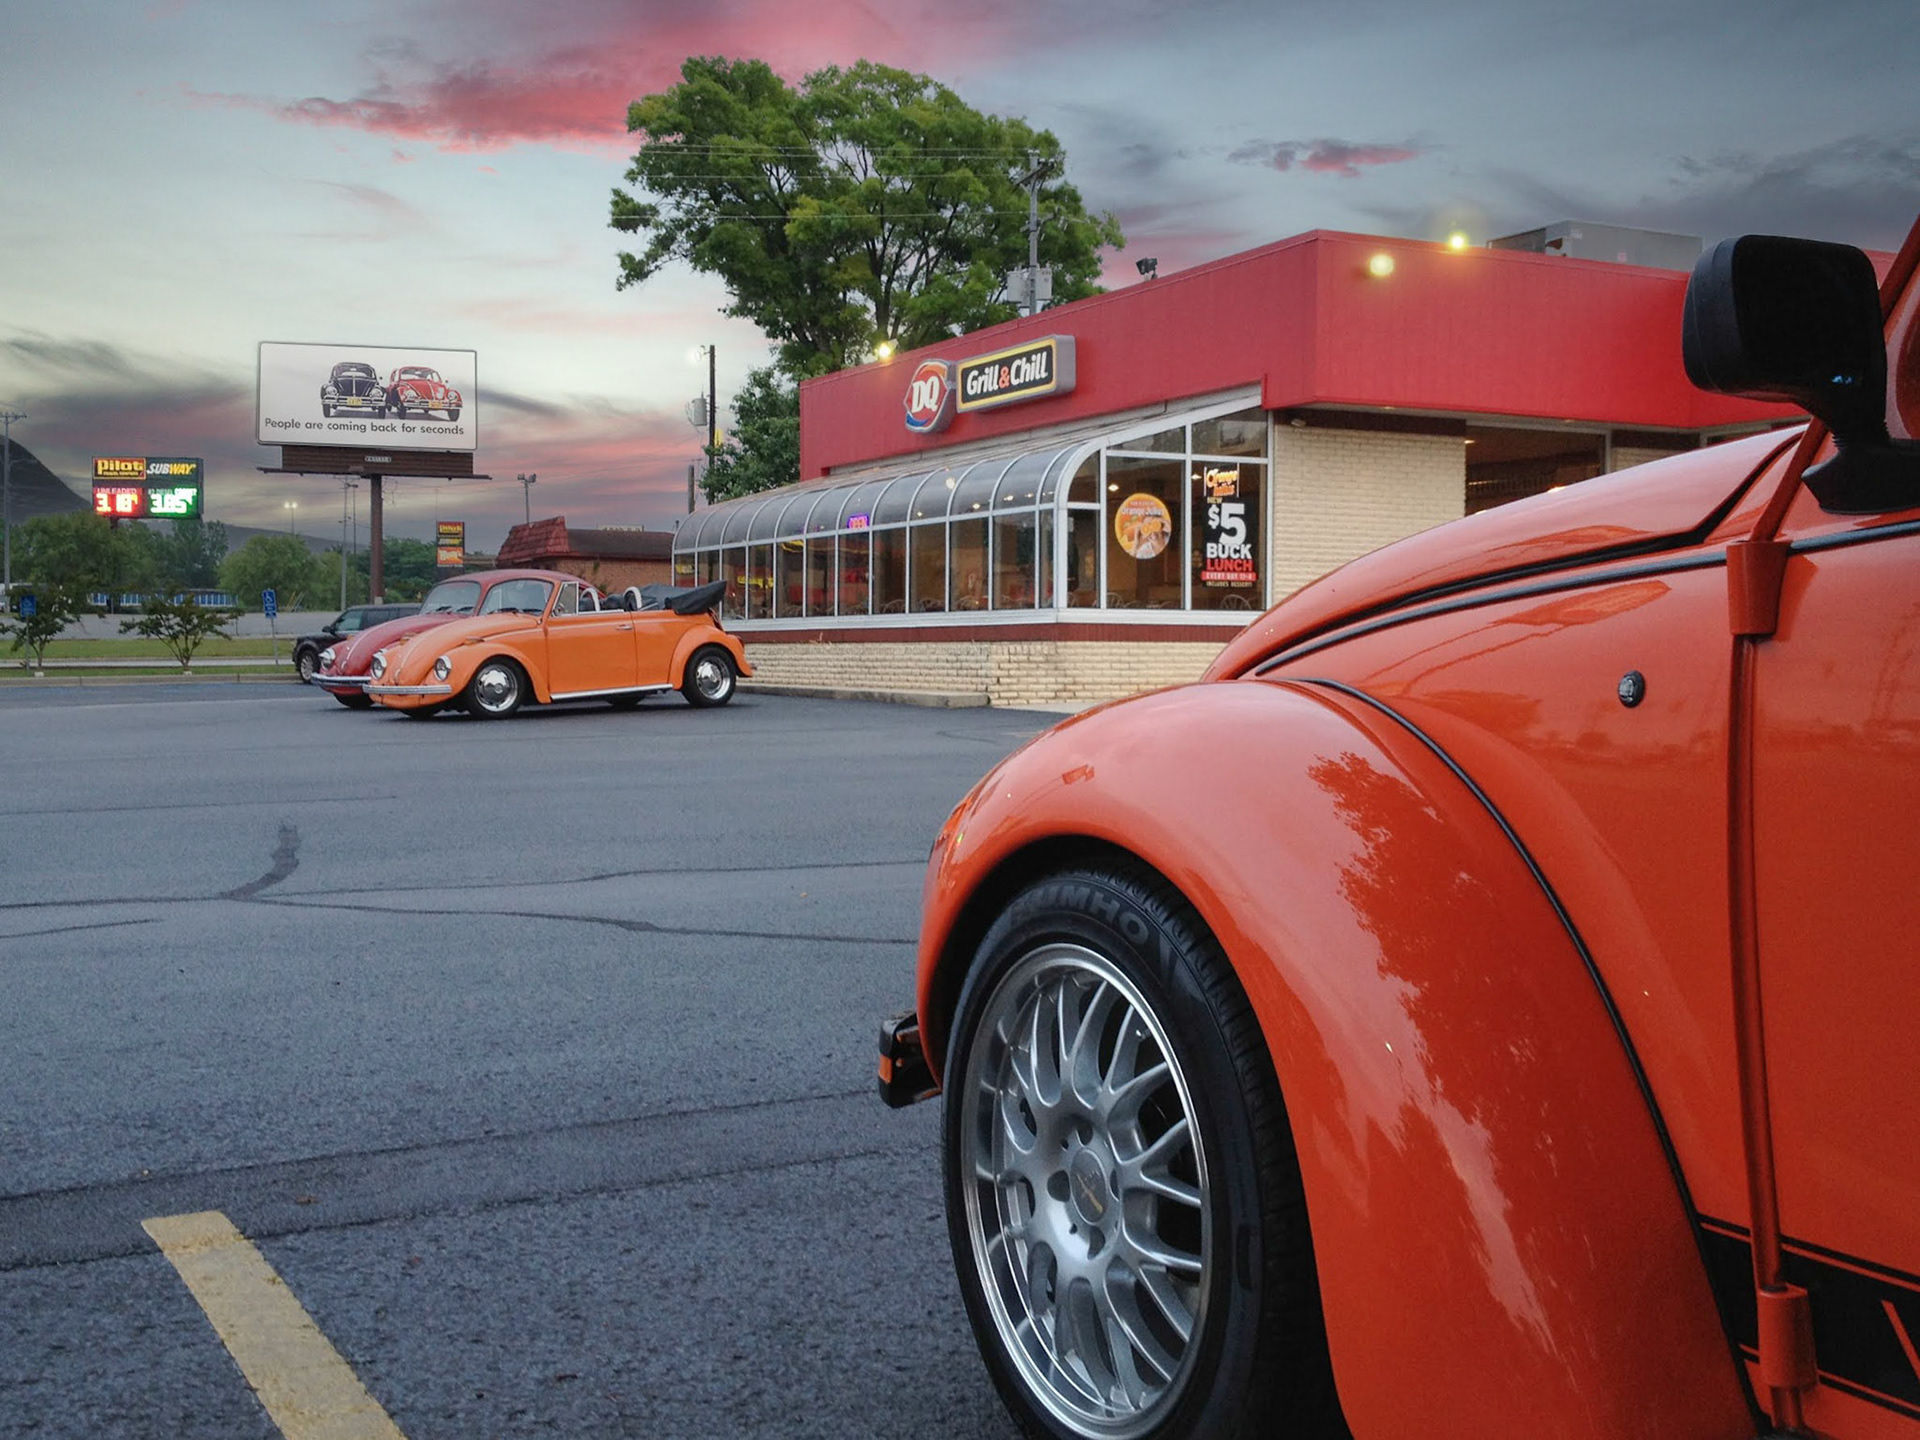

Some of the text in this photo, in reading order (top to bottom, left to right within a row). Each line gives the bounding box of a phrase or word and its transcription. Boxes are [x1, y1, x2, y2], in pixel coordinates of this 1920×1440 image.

[911, 376, 940, 413] DQ
[265, 418, 464, 435] People are coming back for seconds
[146, 463, 194, 475] SUBWAY
[1207, 503, 1246, 545] $5
[1206, 542, 1252, 559] BUCK
[1206, 558, 1253, 572] LUNCH
